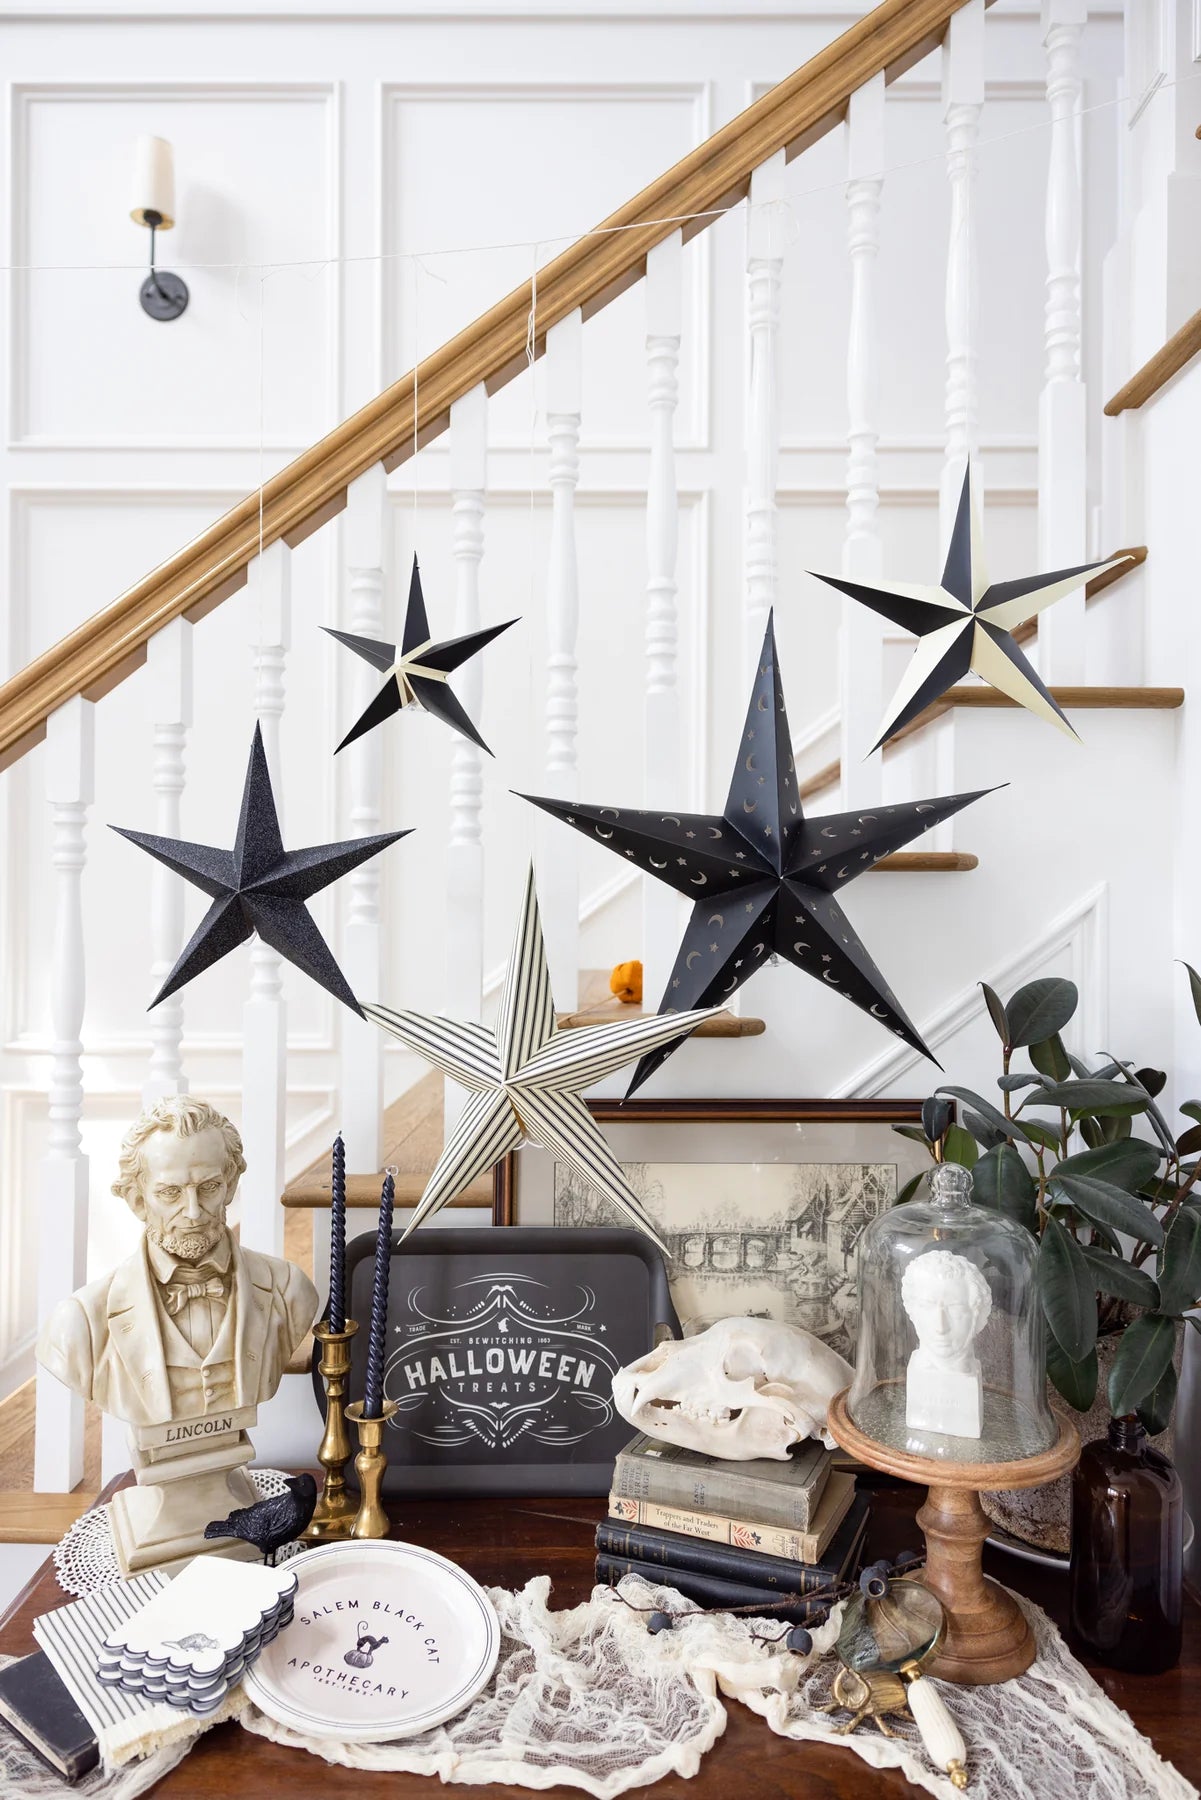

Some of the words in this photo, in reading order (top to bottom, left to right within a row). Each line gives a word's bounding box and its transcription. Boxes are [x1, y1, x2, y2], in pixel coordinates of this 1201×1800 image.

[409, 1325, 426, 1333] TRADE
[576, 1324, 592, 1332] MARK
[468, 1337, 532, 1345] BEWITCHING
[404, 1348, 596, 1390] HALLOWEEN
[458, 1382, 536, 1393] TREATS
[165, 1418, 233, 1442] LINCOLN
[642, 1471, 651, 1496] SAGE
[656, 1508, 681, 1520] Trappers
[696, 1518, 719, 1529] Traders
[671, 1521, 682, 1529] the
[683, 1524, 693, 1532] Far
[694, 1526, 711, 1537] West
[768, 1576, 777, 1584] 5
[300, 1600, 360, 1626] SALEM
[372, 1600, 425, 1631] BLACK
[424, 1638, 440, 1664] CAT
[287, 1657, 410, 1700] APOTHECARY
